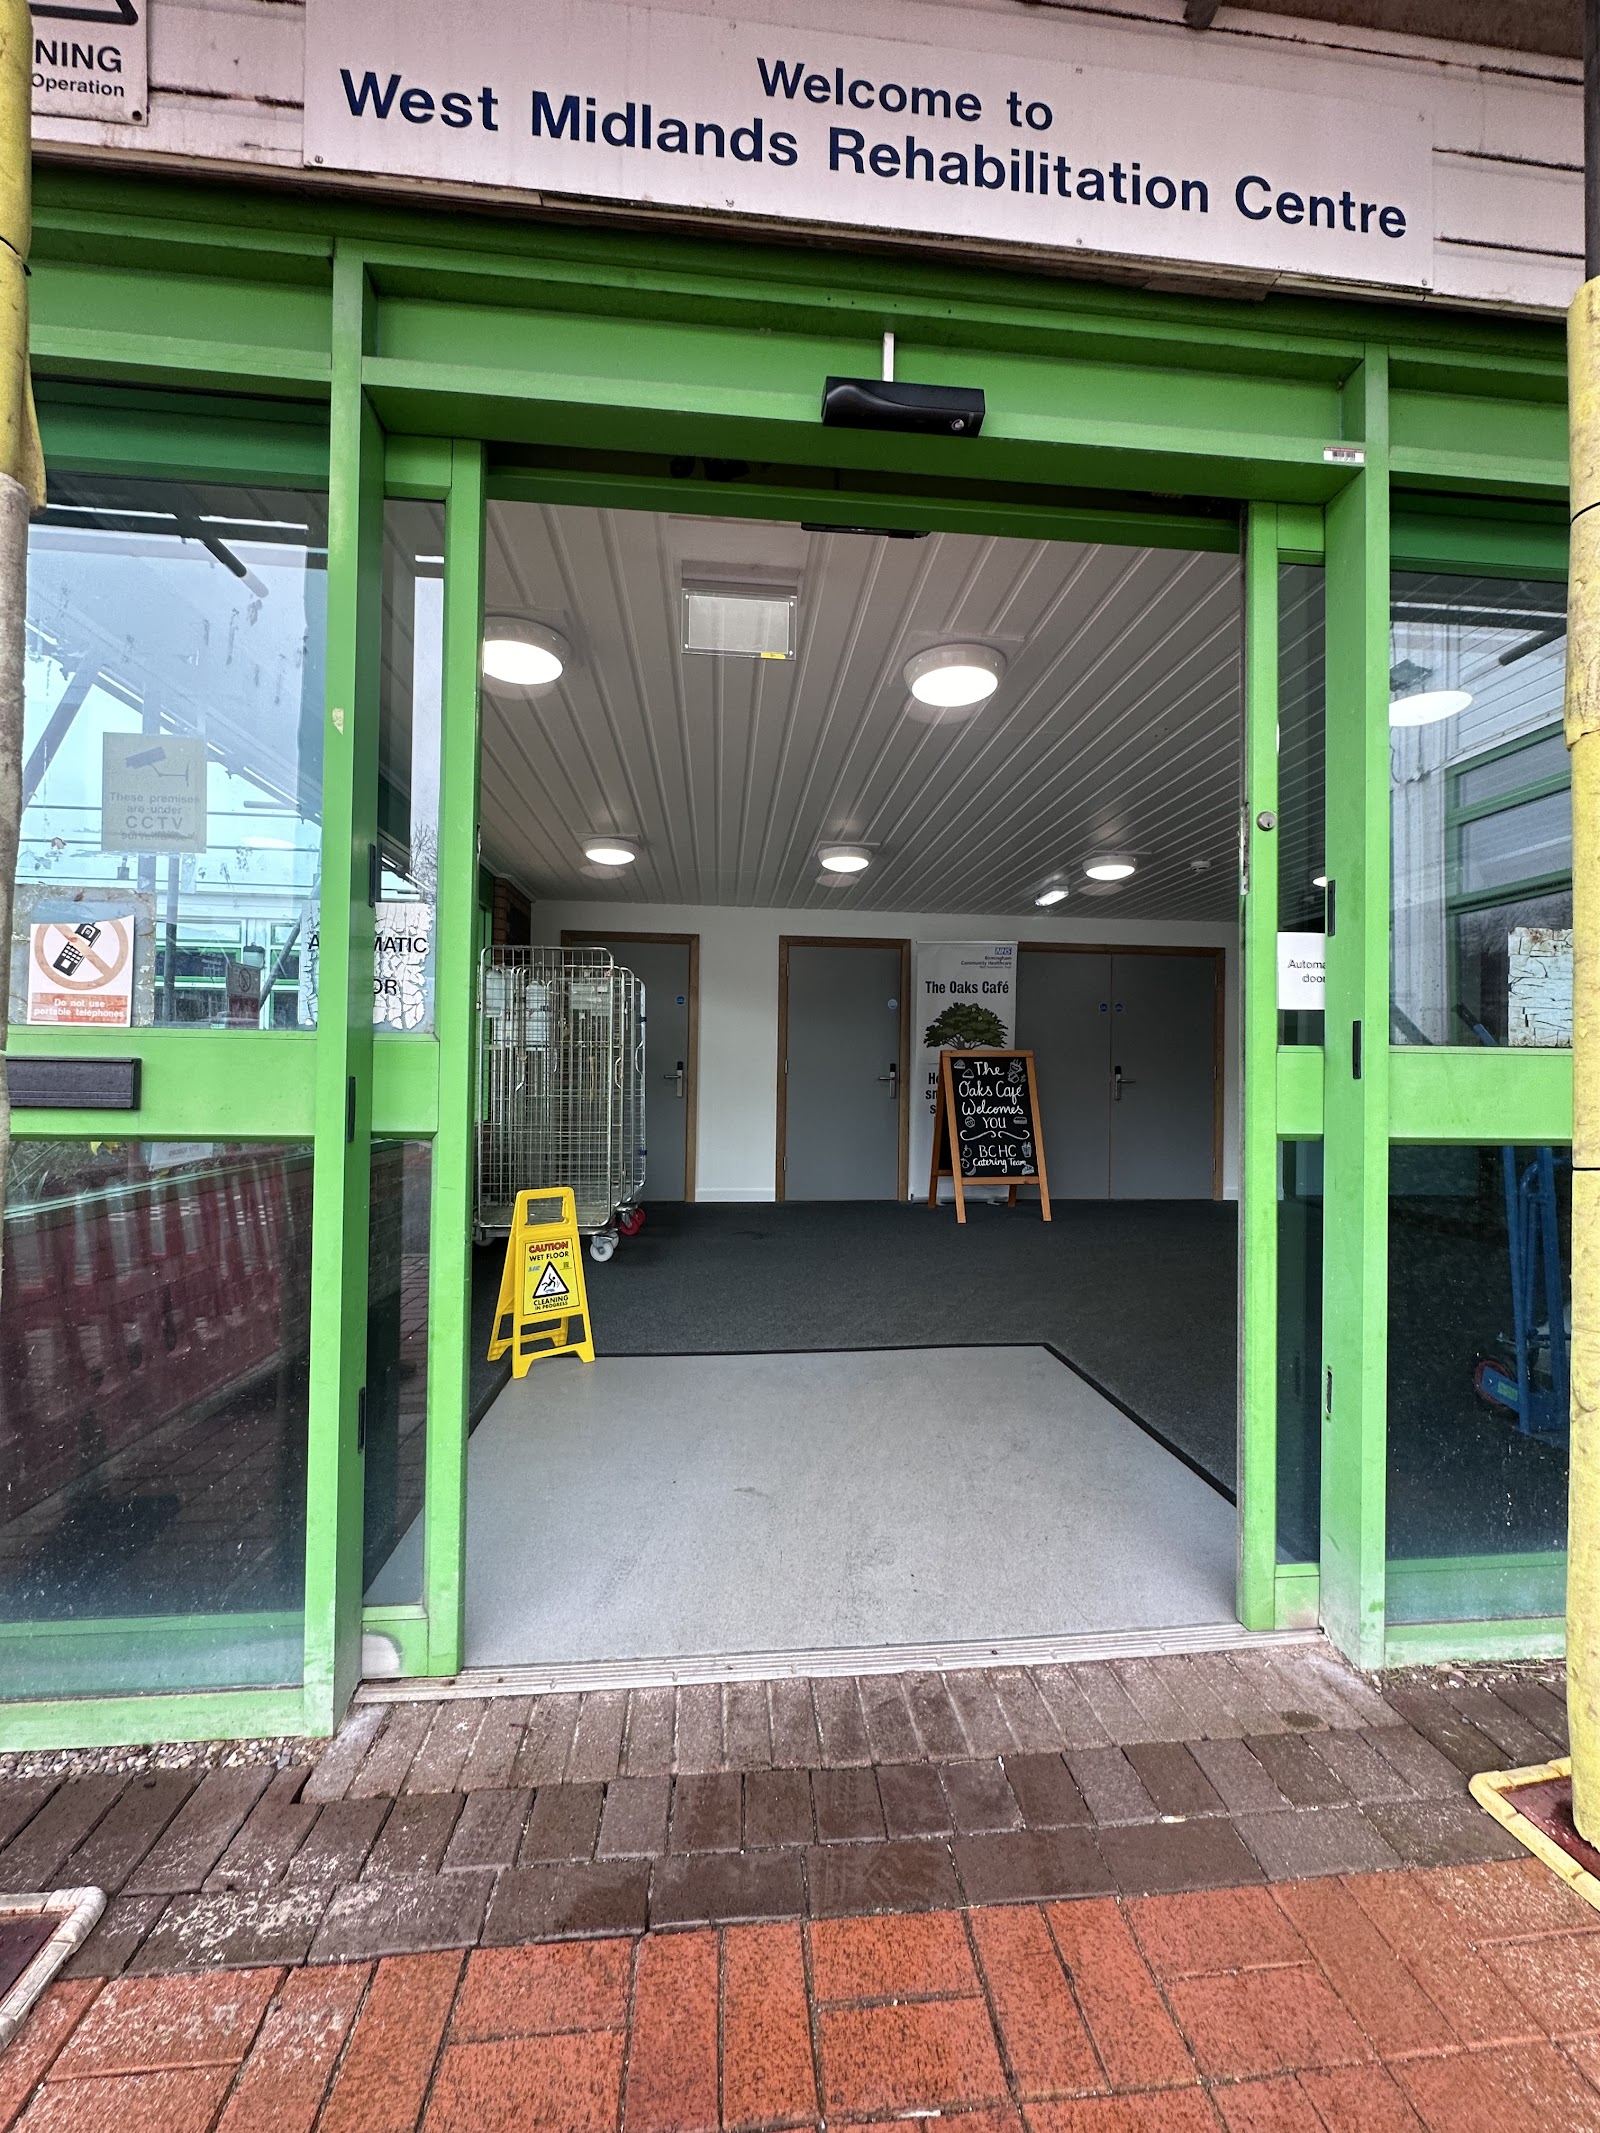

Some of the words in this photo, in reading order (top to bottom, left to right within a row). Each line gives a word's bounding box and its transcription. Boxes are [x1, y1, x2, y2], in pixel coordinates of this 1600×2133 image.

[32, 73, 125, 98] Operation
[757, 57, 982, 122] Welcome
[1006, 91, 1054, 131] to
[340, 68, 499, 131] West
[531, 90, 798, 167] Midlands
[828, 126, 1209, 213] Rehabilitation
[1235, 175, 1407, 239] Centre
[110, 792, 144, 802] These
[127, 804, 145, 814] are
[150, 804, 183, 815] under
[125, 815, 183, 830] CCTV
[995, 947, 1012, 955] NHS
[925, 981, 946, 994] The
[949, 981, 979, 994] Oaks
[982, 981, 1009, 994] Café
[54, 998, 67, 1007] Do
[71, 999, 85, 1007] not
[89, 1000, 106, 1008] use
[34, 1007, 71, 1016] portable
[76, 1008, 125, 1018] telephones
[974, 1061, 1005, 1076] The
[958, 1080, 993, 1098] Oaks
[995, 1080, 1025, 1105] Café
[961, 1099, 1024, 1116] Welcomes
[982, 1117, 1007, 1129] YOU
[972, 1158, 1008, 1174] Catering
[1009, 1157, 1027, 1166] Team
[529, 1241, 569, 1253] CAUTION
[546, 1251, 569, 1259] FLOOR
[533, 1295, 569, 1306] CLEANING
[542, 1301, 568, 1309] PROGRESS
